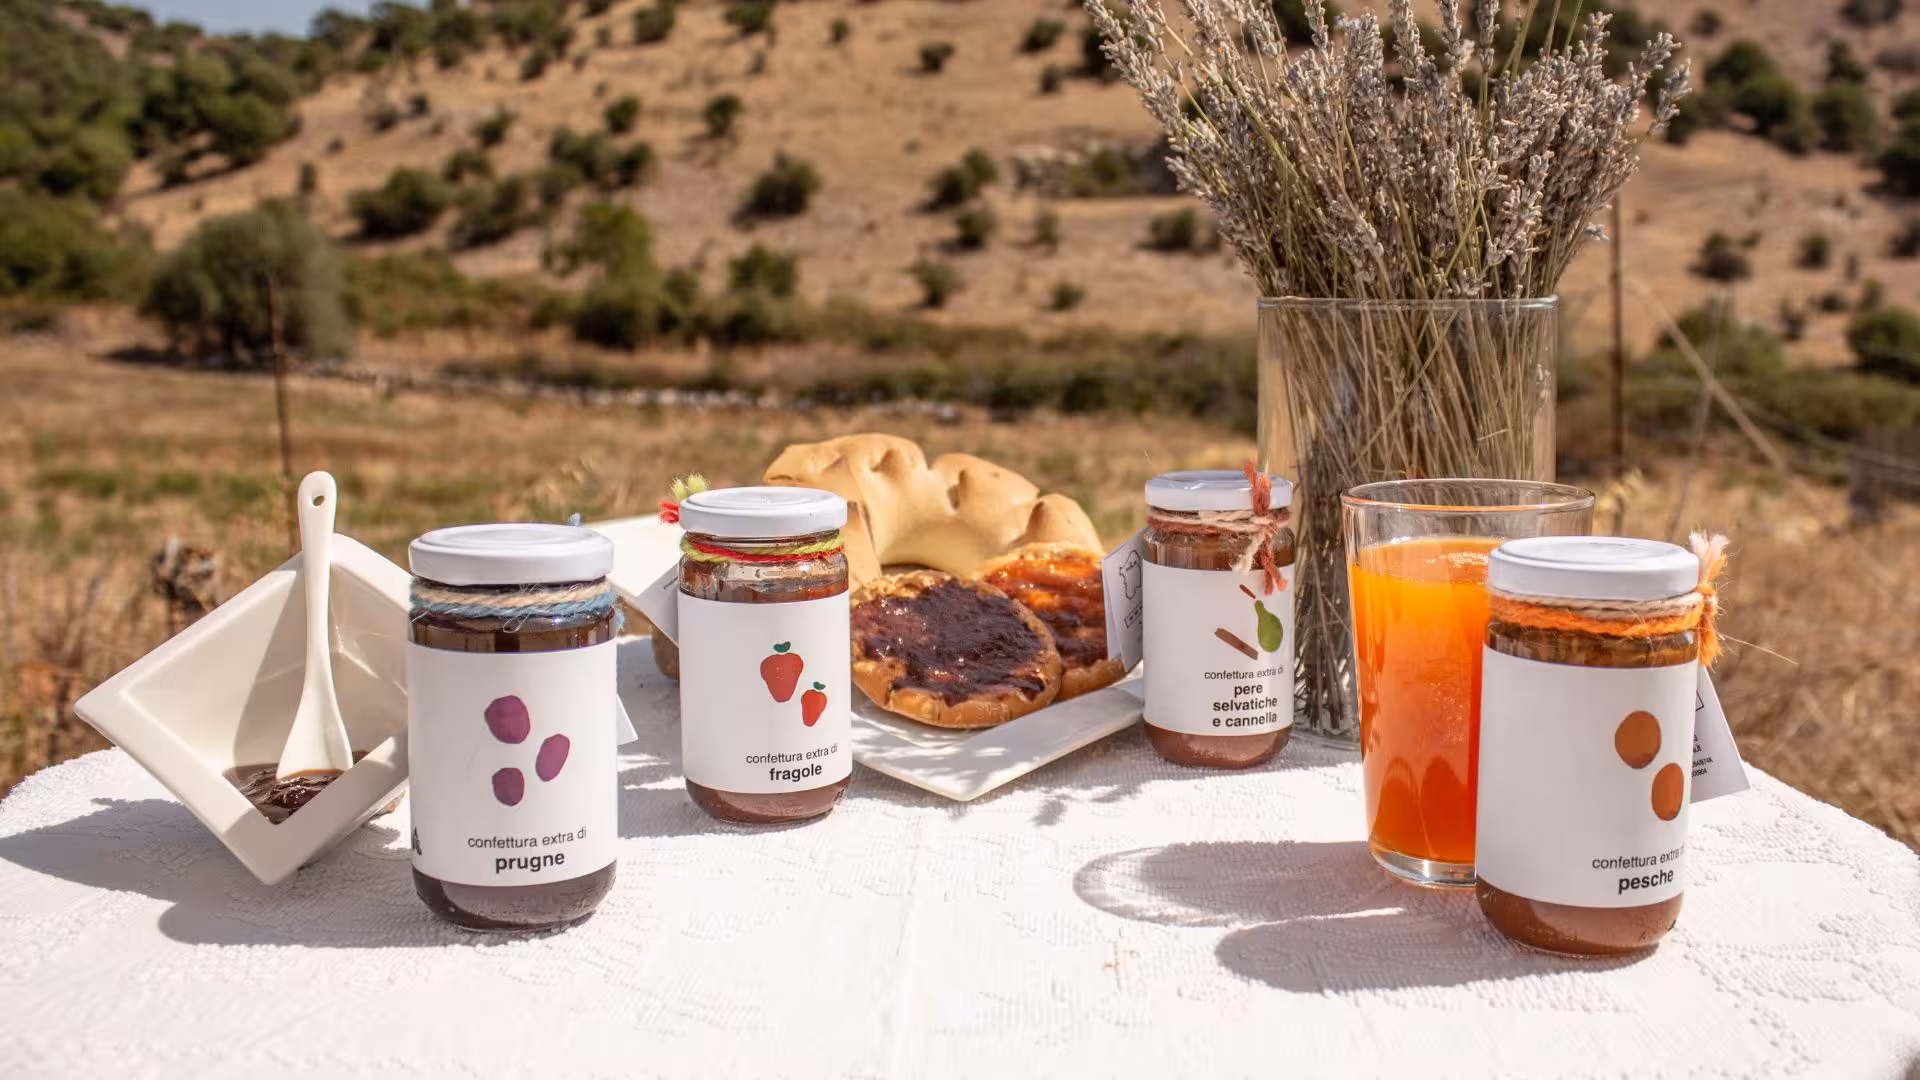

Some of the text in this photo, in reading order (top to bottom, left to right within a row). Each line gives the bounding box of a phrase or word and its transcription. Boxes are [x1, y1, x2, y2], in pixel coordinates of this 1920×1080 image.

[1204, 670, 1254, 680] confettura
[1257, 668, 1276, 678] extra
[1233, 684, 1263, 698] pere
[1212, 696, 1278, 711] selvatiche
[1212, 711, 1277, 727] e cannella
[745, 742, 838, 764] confettura extra di
[769, 763, 823, 782] fragole
[467, 826, 587, 849] confettura extra di
[495, 852, 566, 874] prugne
[1592, 856, 1657, 869] confettura
[1660, 847, 1680, 864] extra
[1618, 868, 1675, 895] pesche
